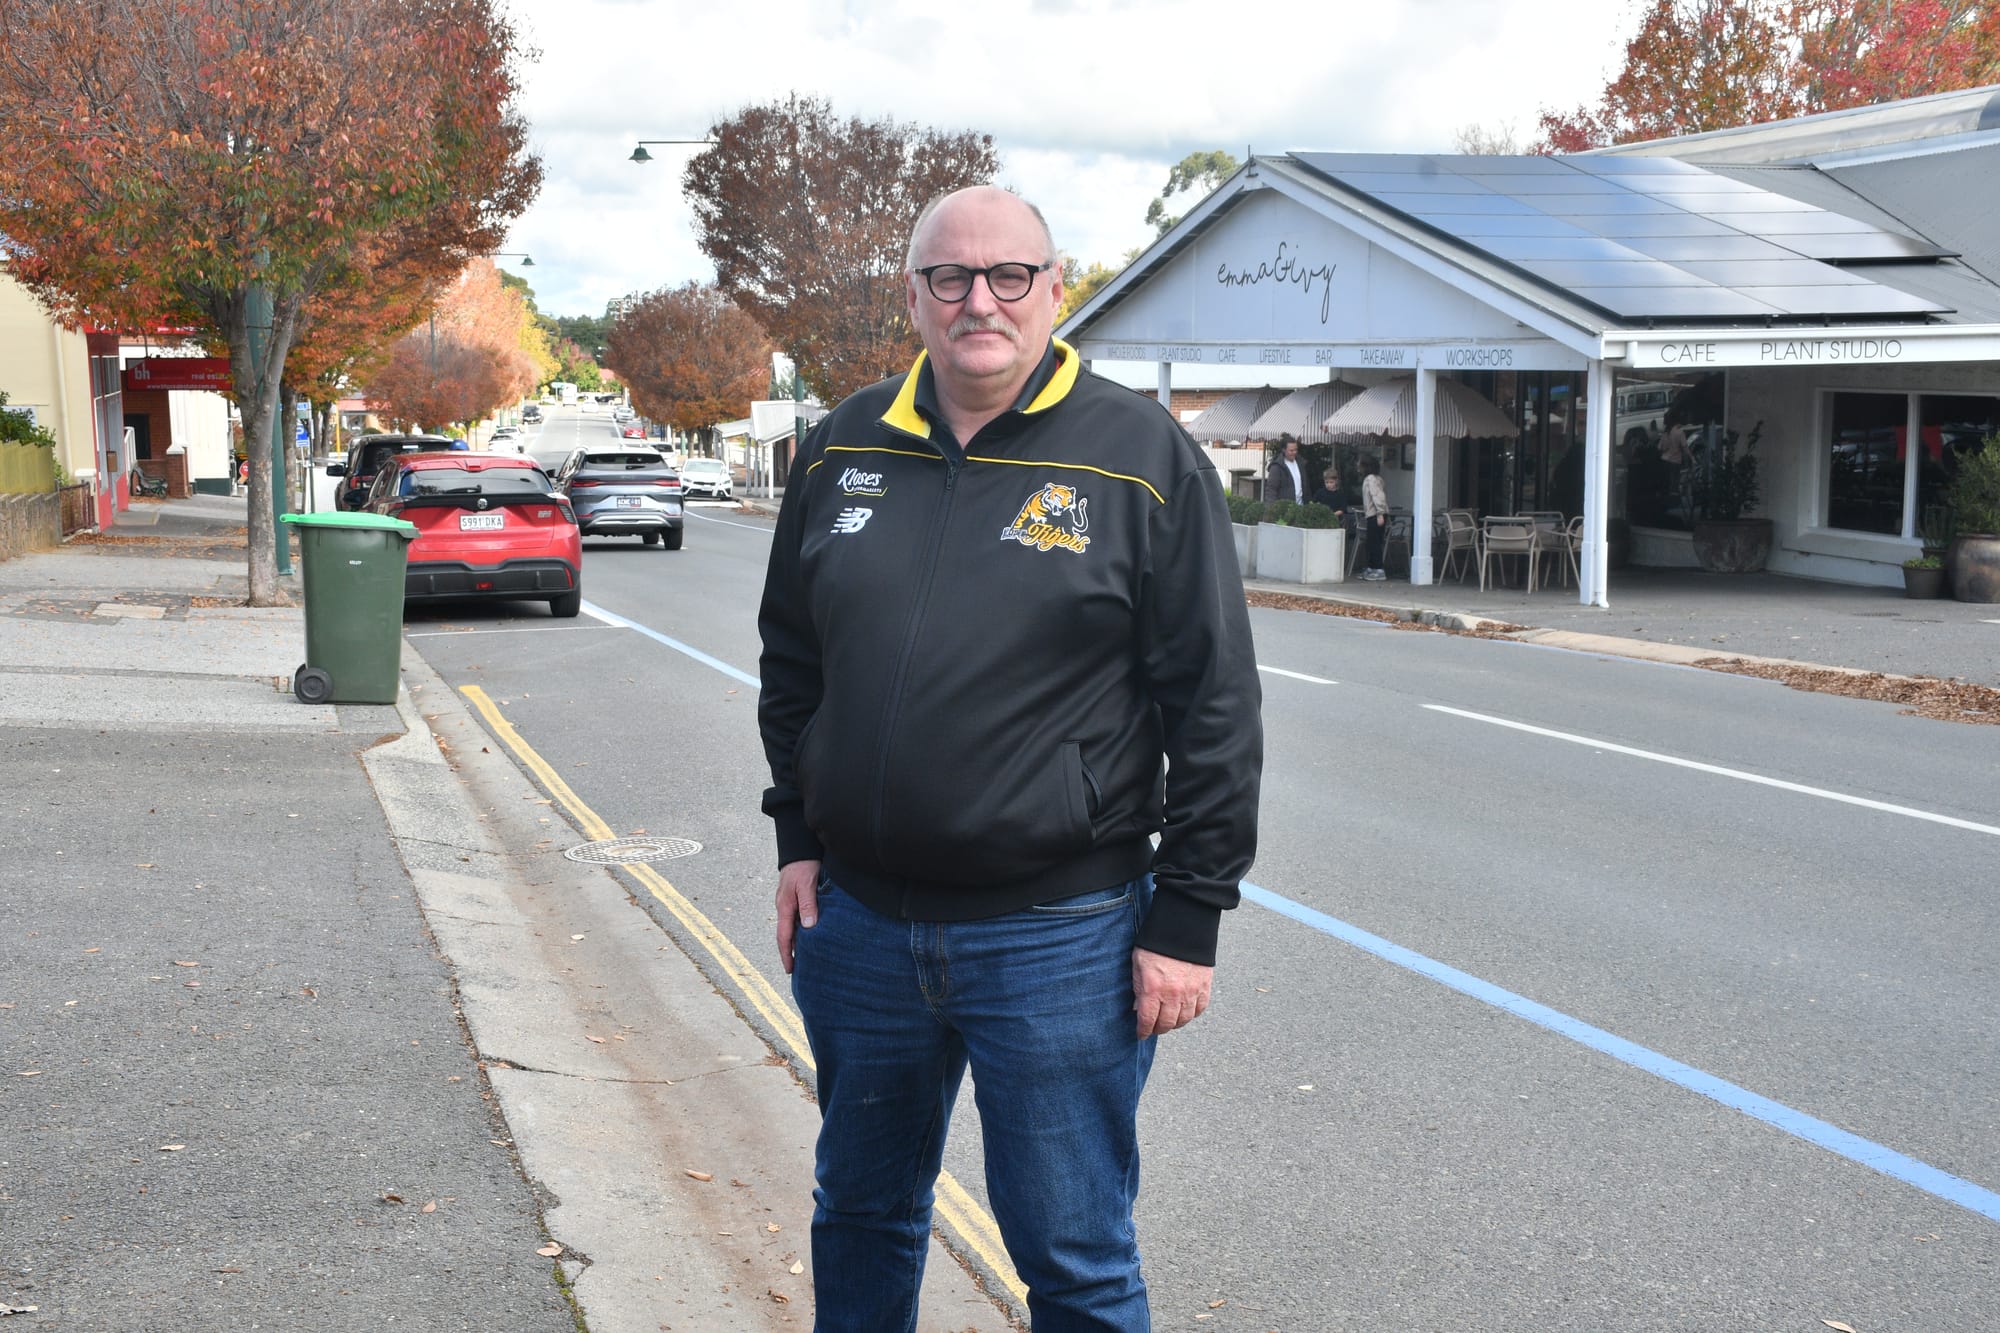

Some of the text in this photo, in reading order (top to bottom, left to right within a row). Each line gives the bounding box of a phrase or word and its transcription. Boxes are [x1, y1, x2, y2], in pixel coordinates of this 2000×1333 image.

[1218, 348, 1236, 363] CAFE
[1259, 349, 1291, 364] LIFESTYLE
[1315, 349, 1333, 365] BAR
[1360, 349, 1404, 365] TAKEAWAY
[1446, 349, 1513, 367] WORKSHOPS
[1660, 339, 1902, 363] CAFE PLANT STUDIO
[134, 363, 150, 380] bh
[837, 467, 883, 493] Kloses
[1023, 523, 1090, 553] Tigers
